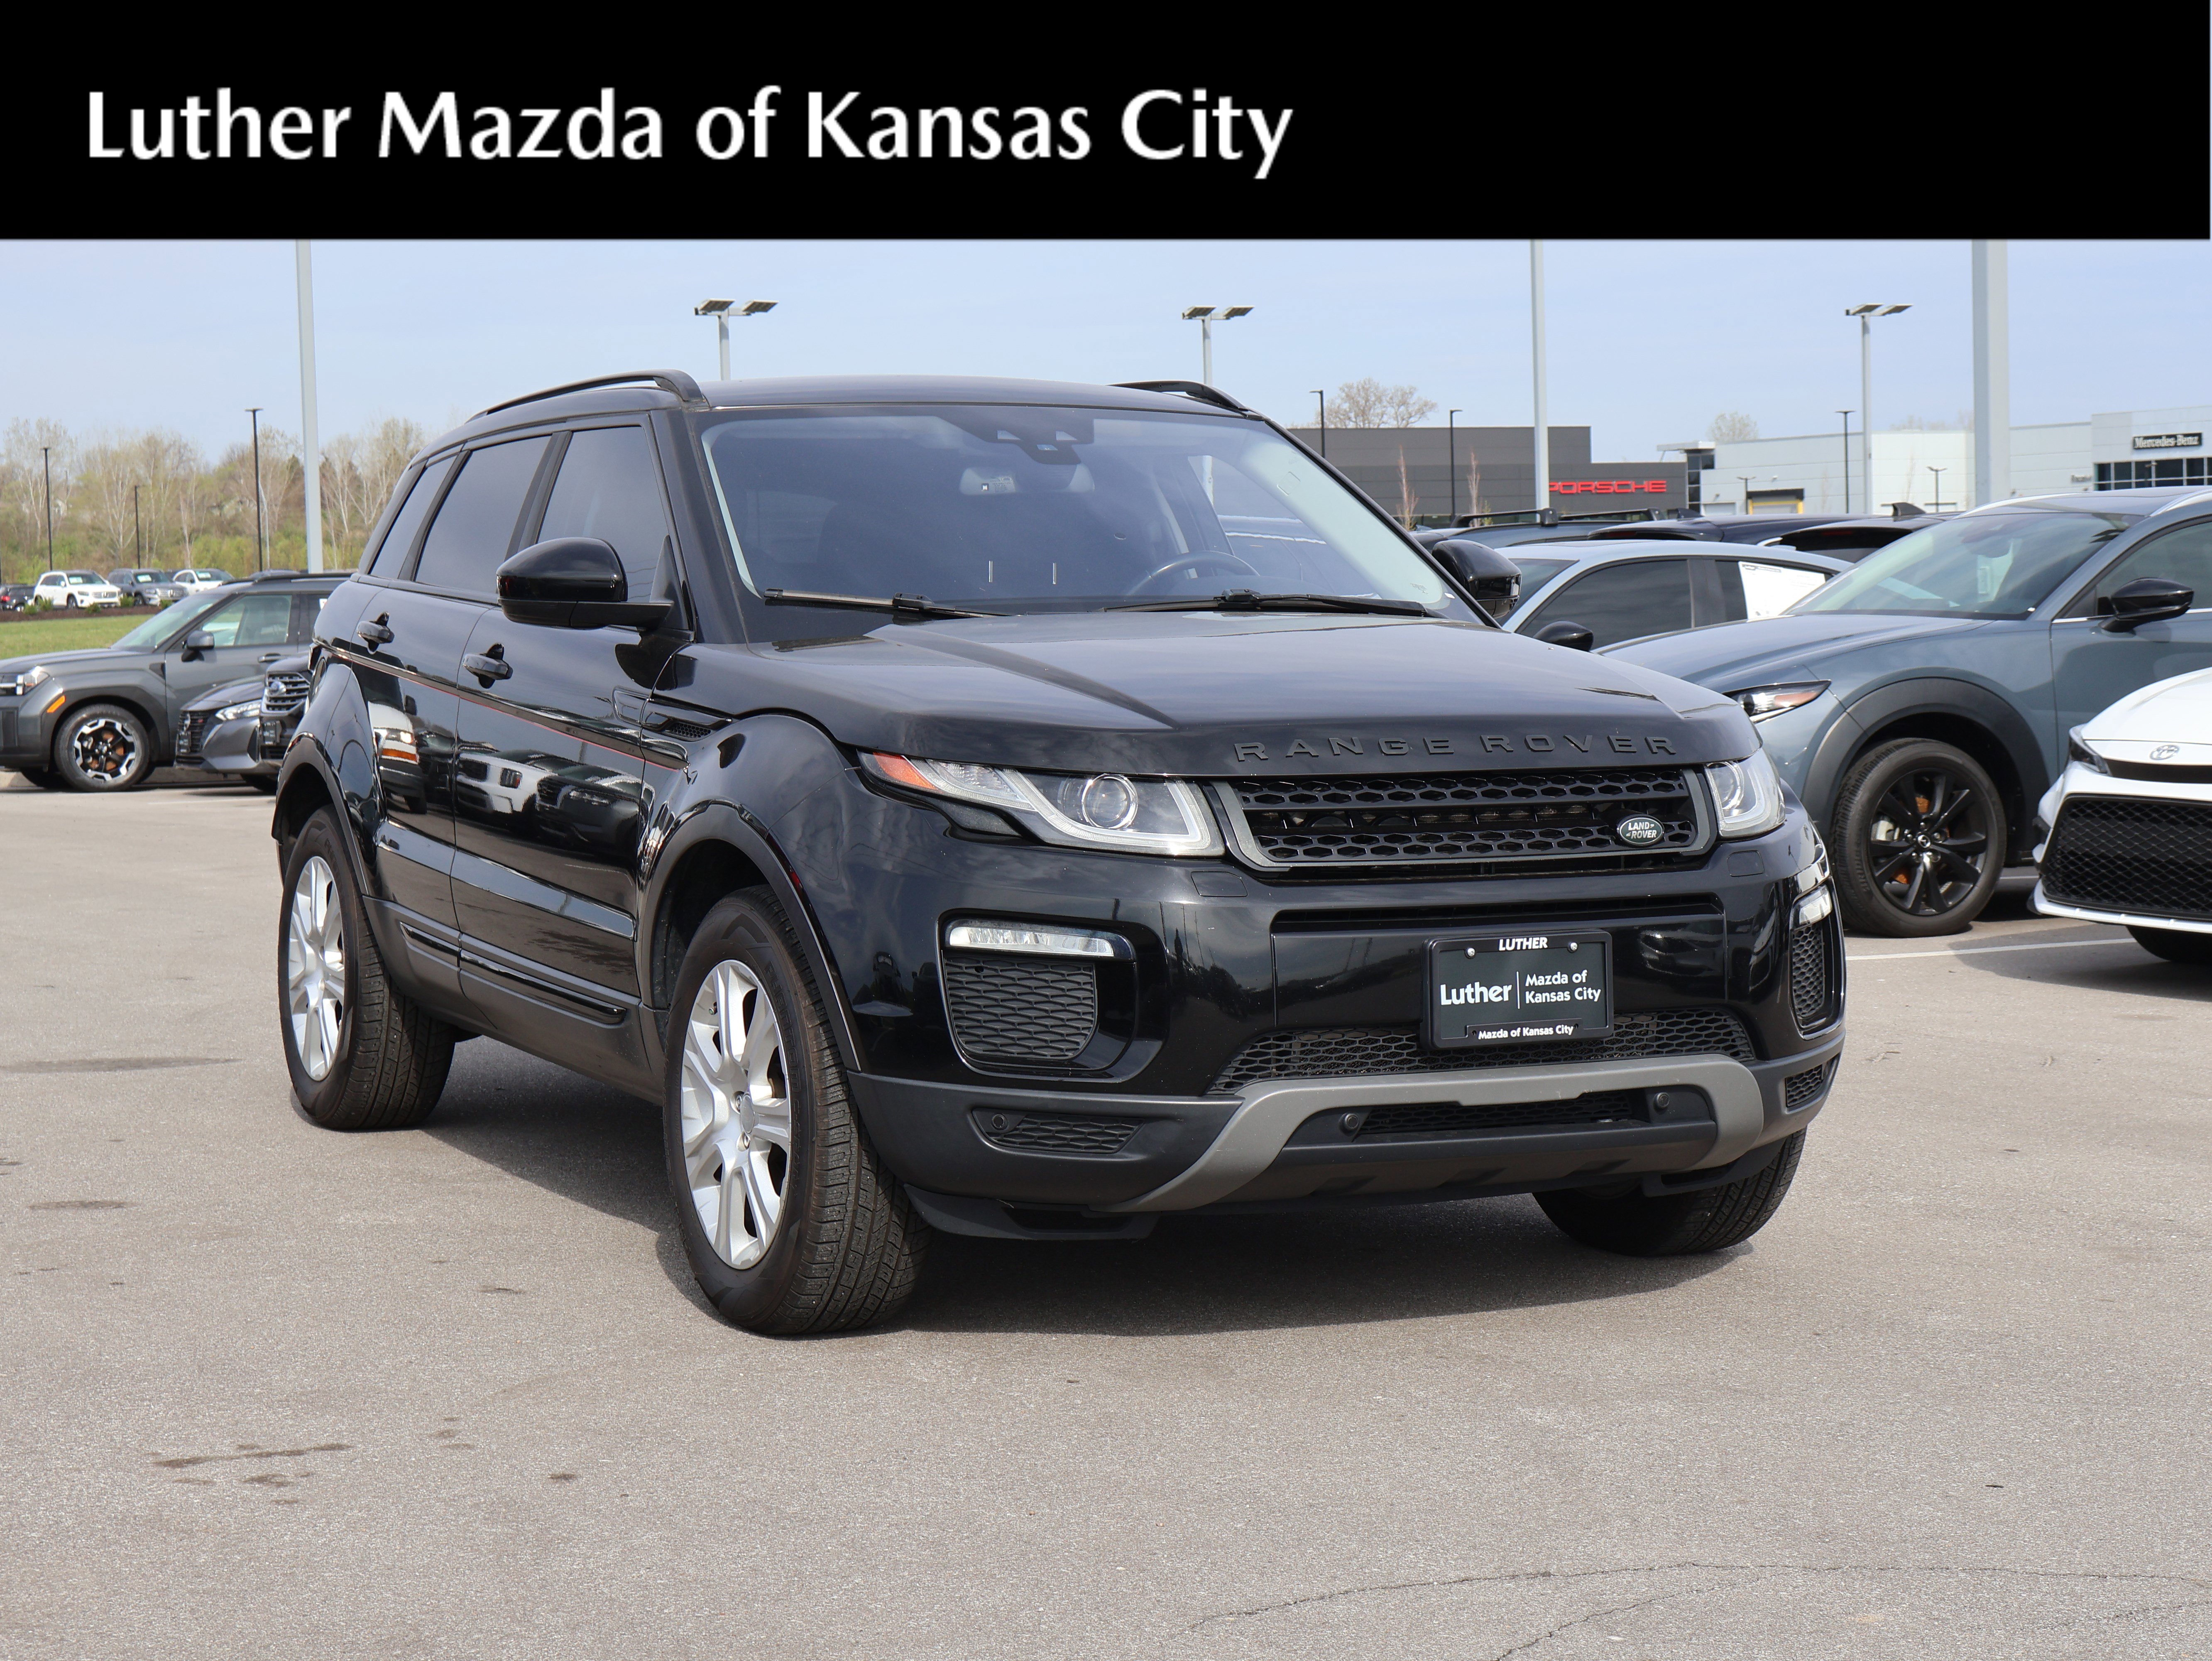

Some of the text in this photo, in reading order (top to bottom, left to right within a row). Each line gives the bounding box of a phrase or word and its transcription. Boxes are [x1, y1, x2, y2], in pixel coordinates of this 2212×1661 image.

[2134, 434, 2199, 448] Mercedes-Benz
[1234, 734, 1676, 761] RANGE ROVER
[1628, 822, 1649, 830] LAND
[1631, 830, 1657, 839] ROVER
[1498, 936, 1548, 951] LUTHER
[1524, 969, 1588, 987] Mazda of
[1440, 981, 1512, 1006] Luther
[1525, 986, 1602, 1004] Kansas City
[1478, 1024, 1574, 1040] Mazda of Kansas City
